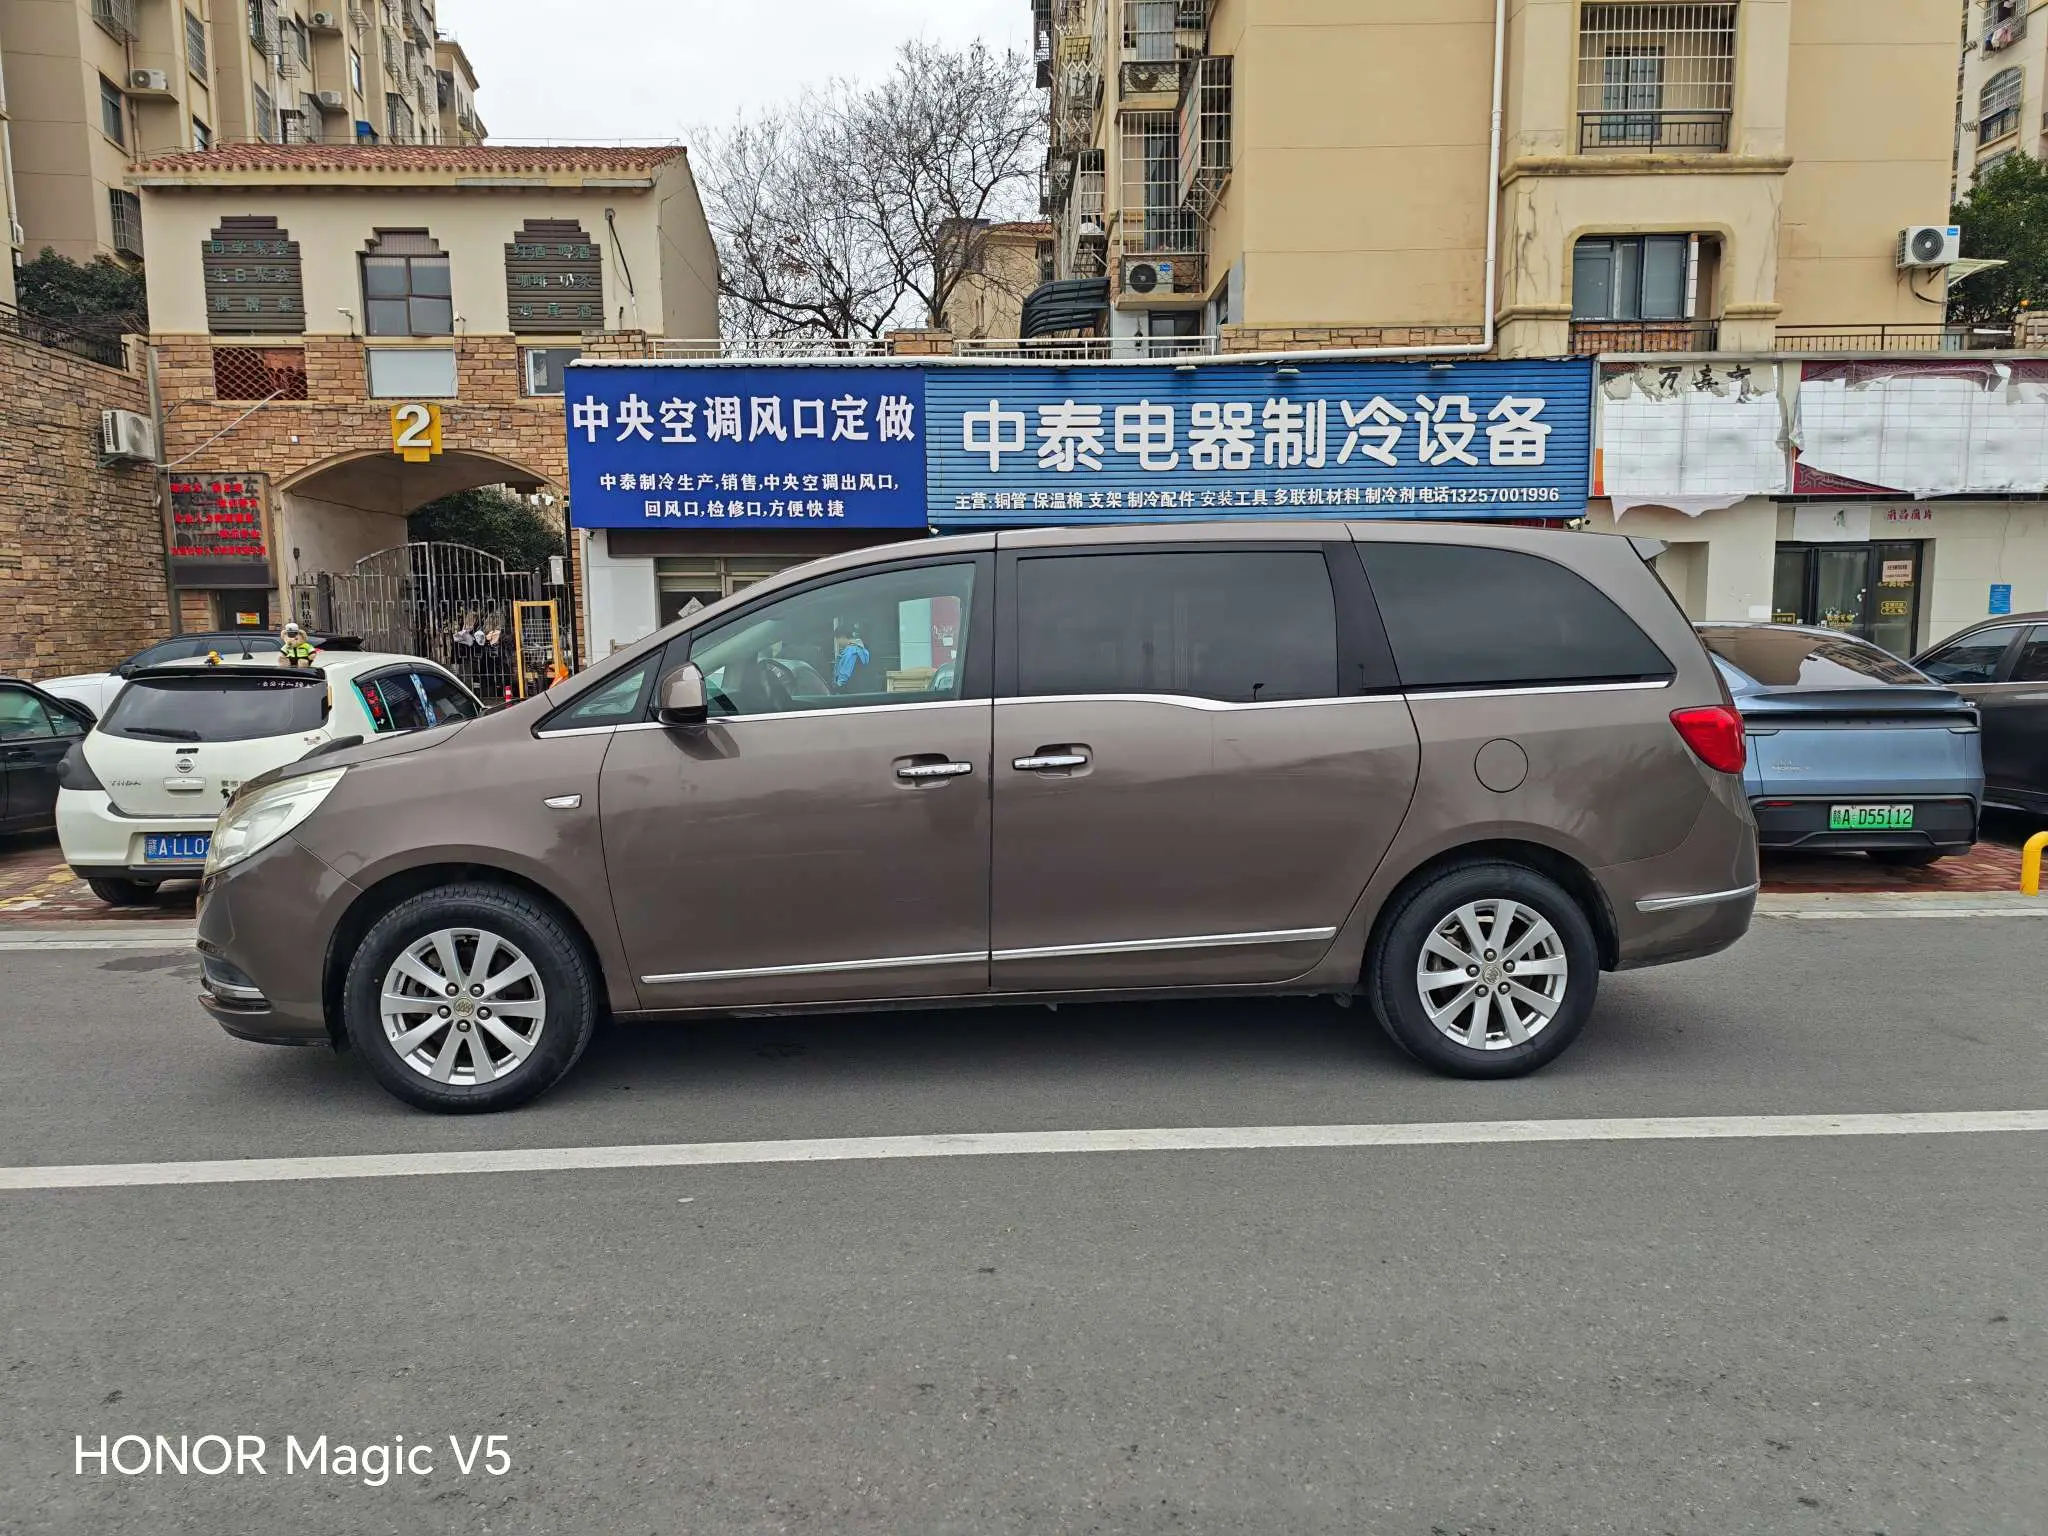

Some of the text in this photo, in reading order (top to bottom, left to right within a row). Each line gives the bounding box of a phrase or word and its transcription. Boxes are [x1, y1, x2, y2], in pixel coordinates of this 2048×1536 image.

[396, 403, 433, 447] 2
[572, 394, 915, 444] 中央空调风口定做
[963, 395, 1552, 473] 中泰电器制冷设备
[1033, 492, 1083, 509] 保温棉
[1088, 491, 1122, 508] 支架
[1128, 491, 1196, 508] 制冷配件
[1200, 489, 1269, 507] 安装工具
[1273, 487, 1361, 506] 多联机材料
[1365, 487, 1415, 504] 制冷剂
